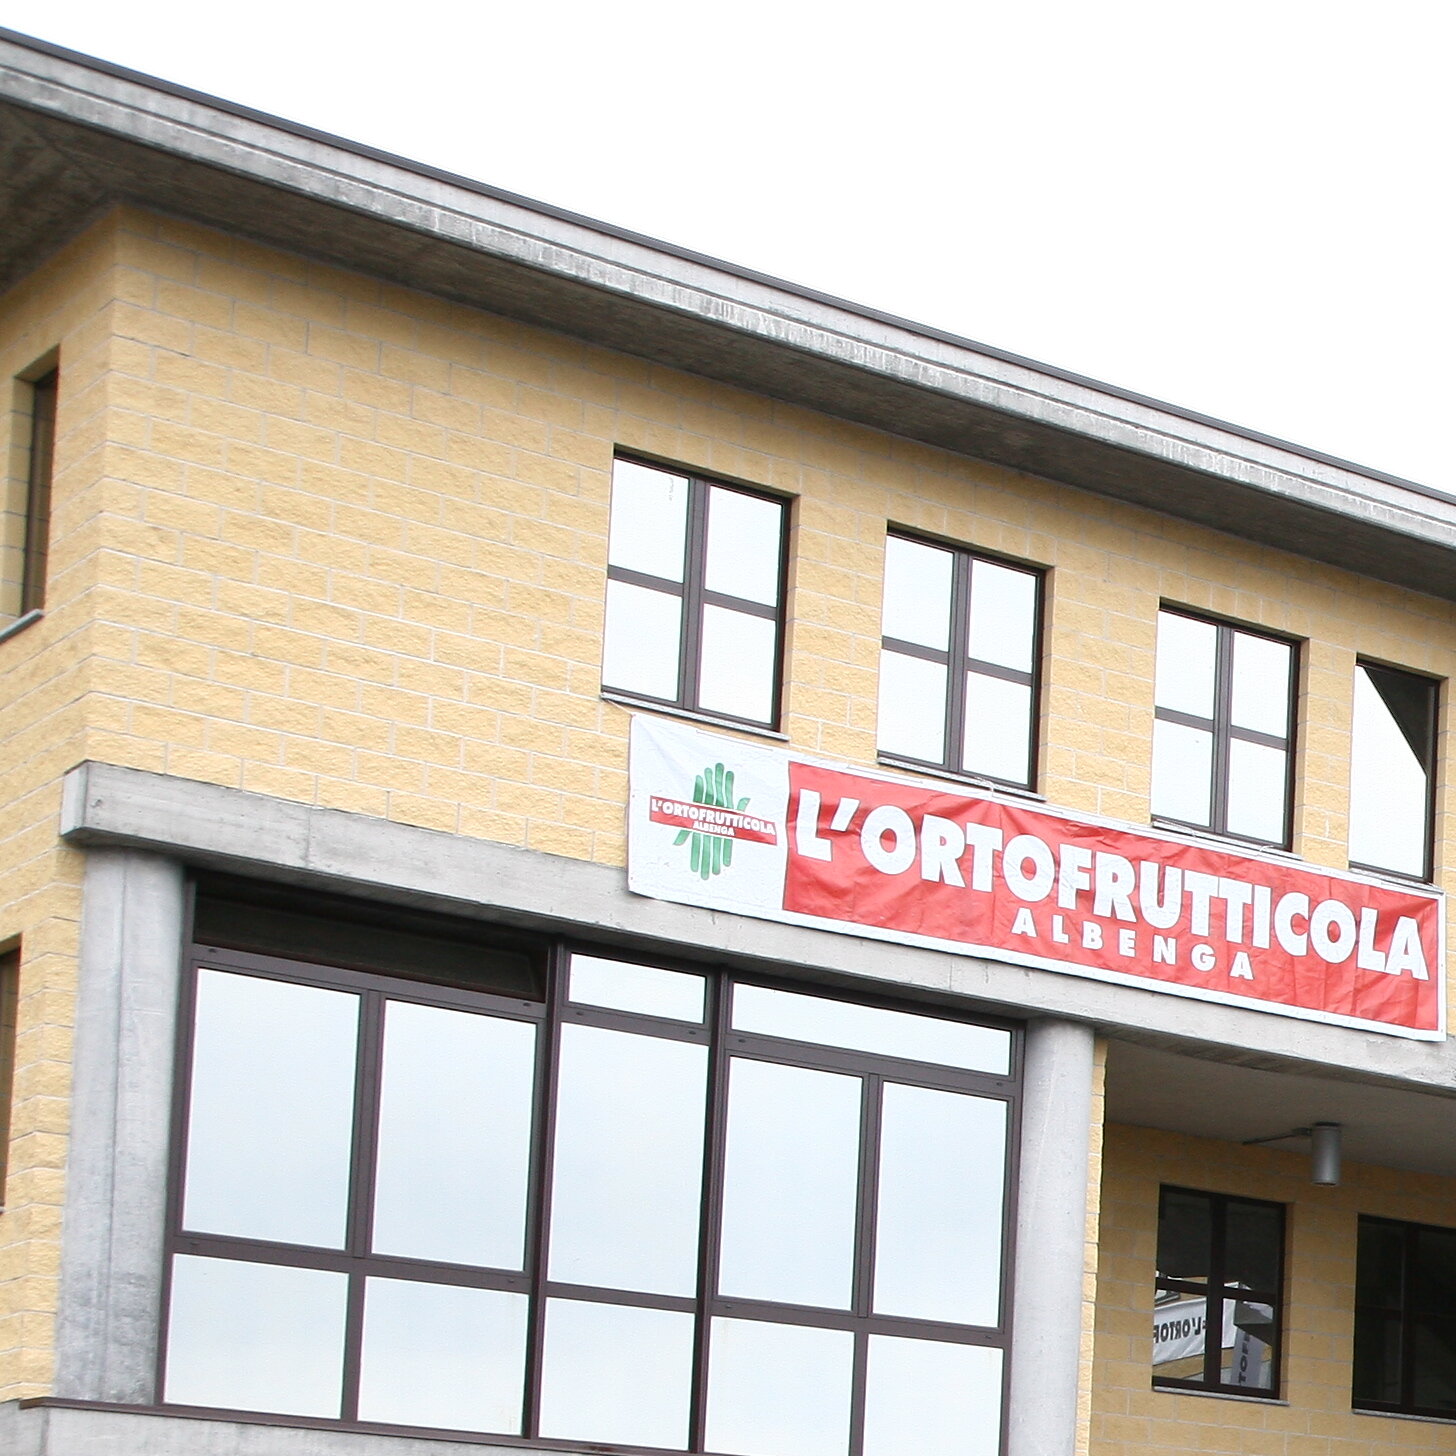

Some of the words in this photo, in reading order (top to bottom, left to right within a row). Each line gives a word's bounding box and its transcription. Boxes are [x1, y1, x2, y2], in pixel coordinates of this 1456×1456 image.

[651, 798, 776, 836] L'ORTOFRUTTICOLA
[796, 788, 1430, 981] L'ORTOFRUTTICOLA
[1011, 907, 1255, 981] ALBENGA
